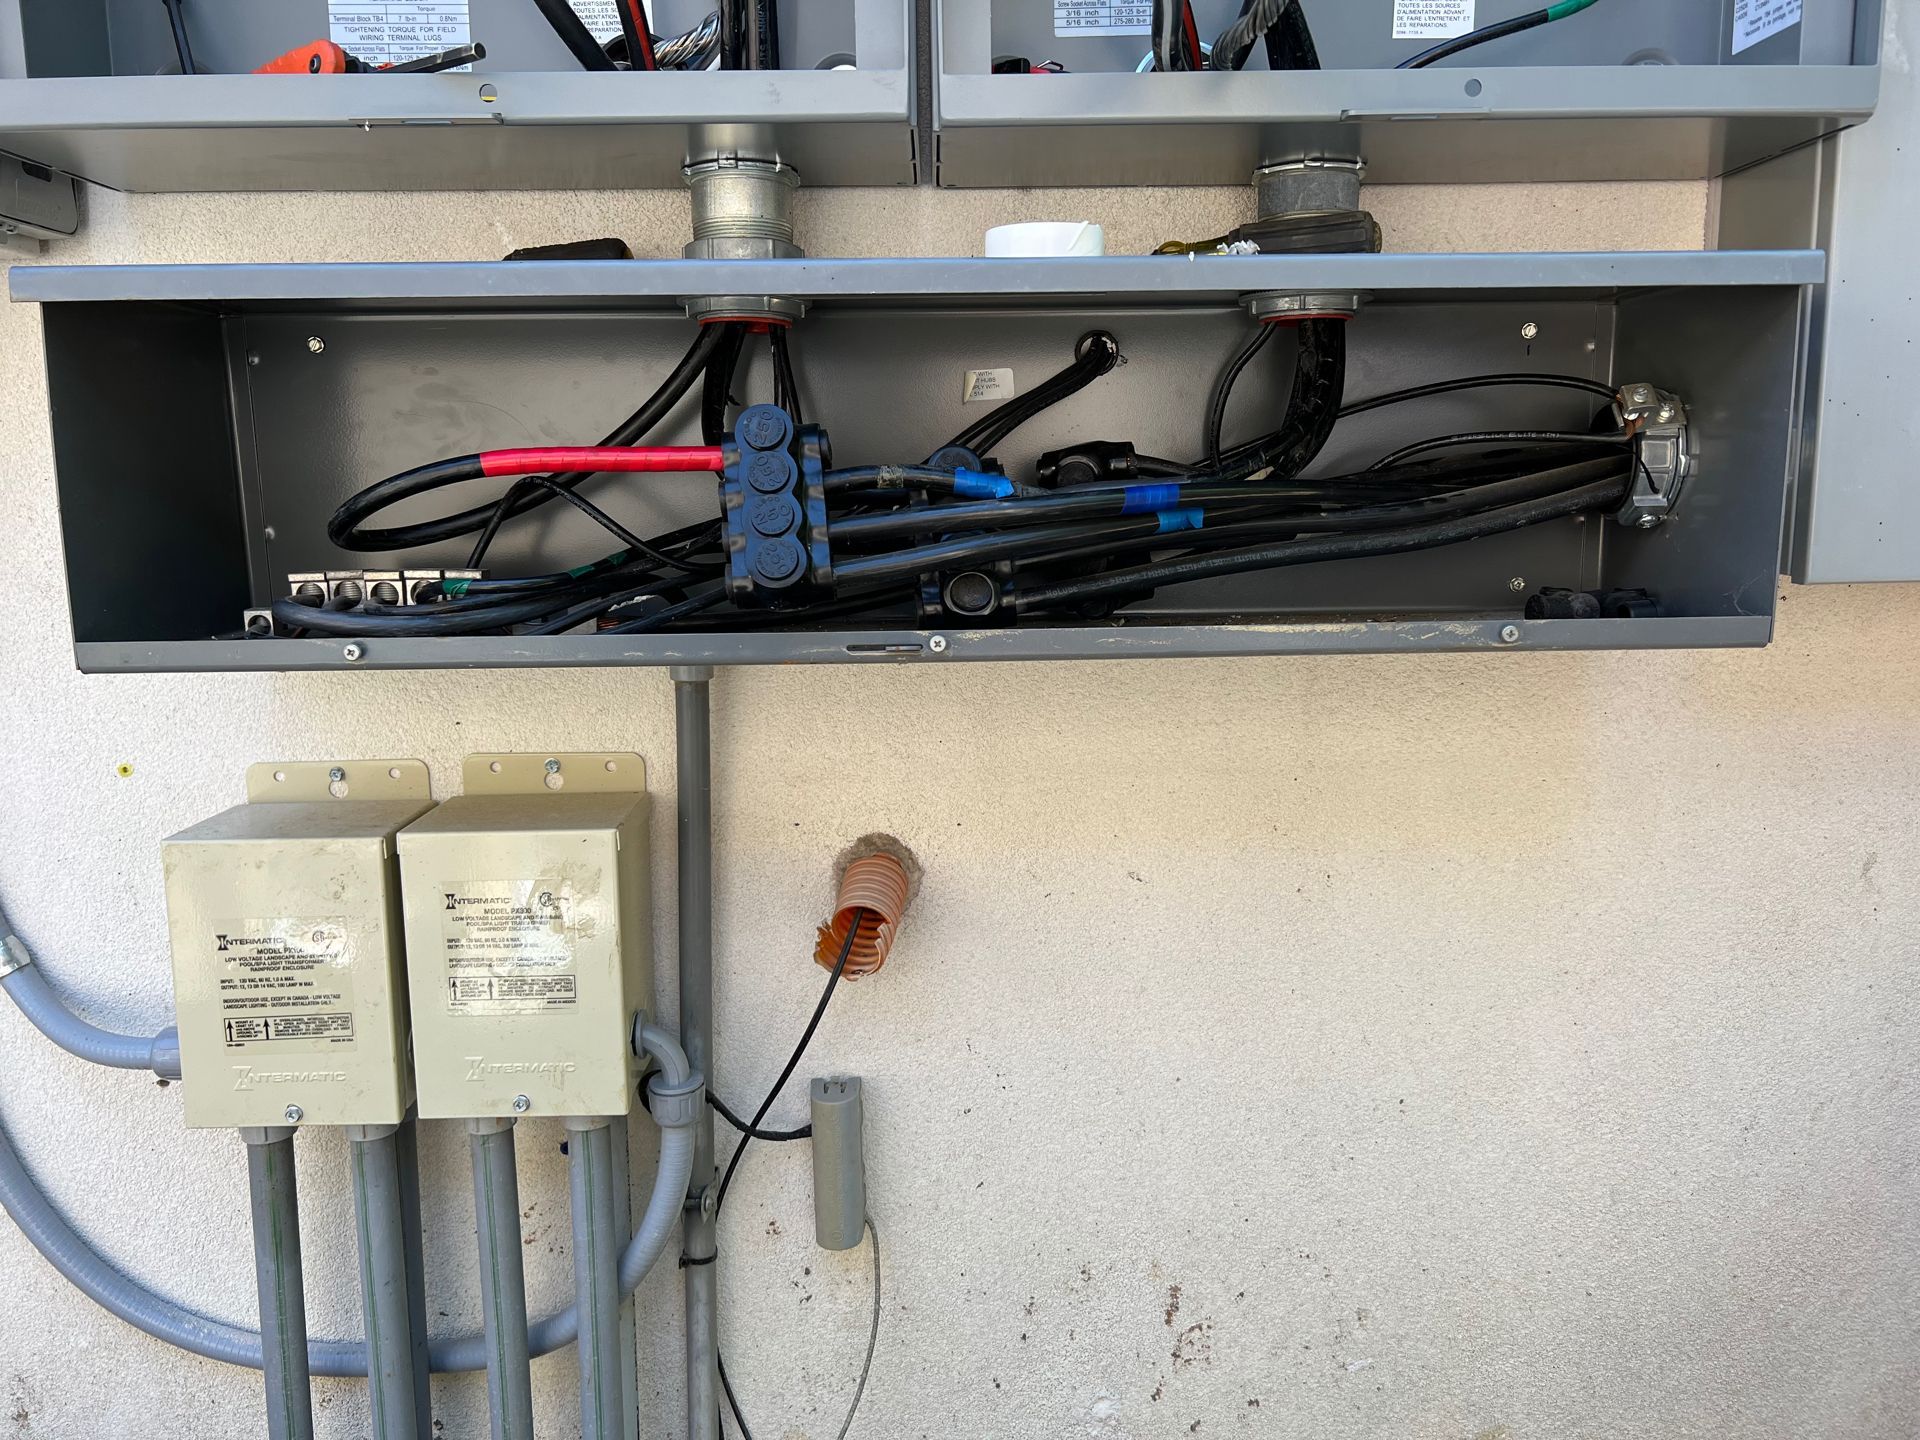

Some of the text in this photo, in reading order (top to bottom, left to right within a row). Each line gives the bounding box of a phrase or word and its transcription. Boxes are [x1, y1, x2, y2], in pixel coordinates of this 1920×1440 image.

[1065, 9, 1081, 17] 3/16
[359, 34, 384, 42] WIRING
[753, 410, 774, 445] 250
[753, 503, 792, 526] 250
[444, 893, 511, 910] INTERMATIC
[484, 907, 509, 915] MODEL
[216, 935, 285, 951] INTERMATIC
[256, 947, 283, 955] MODEL
[464, 1056, 577, 1082] INTERMATIC
[232, 1065, 347, 1092] INTERMATIC
